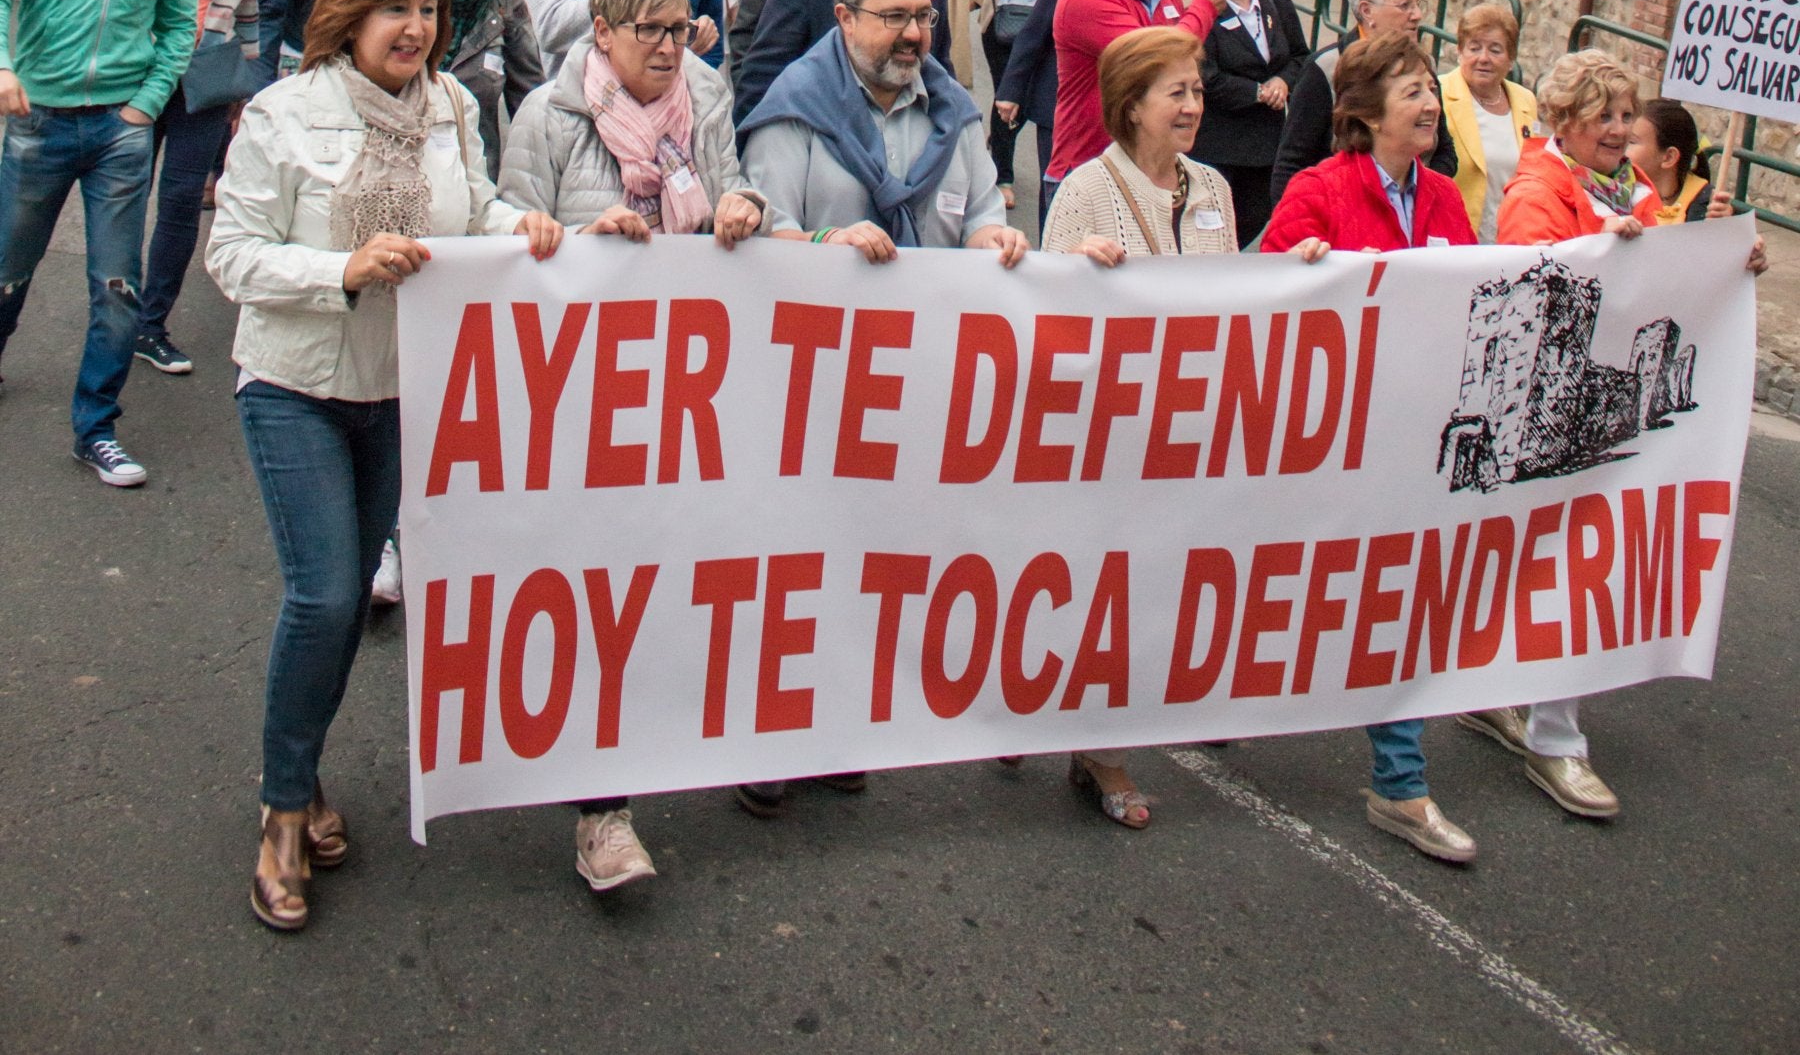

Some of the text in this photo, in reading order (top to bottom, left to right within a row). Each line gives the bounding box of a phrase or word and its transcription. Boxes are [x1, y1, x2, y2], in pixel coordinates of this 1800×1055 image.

[1670, 44, 1800, 103] MOS SALVAR
[1684, 0, 1800, 55] CONSEGU
[426, 261, 1387, 497] AYER TE DEFENDÍ
[420, 564, 660, 774] HOY
[692, 552, 824, 739] TE
[860, 551, 1130, 723] TOCA
